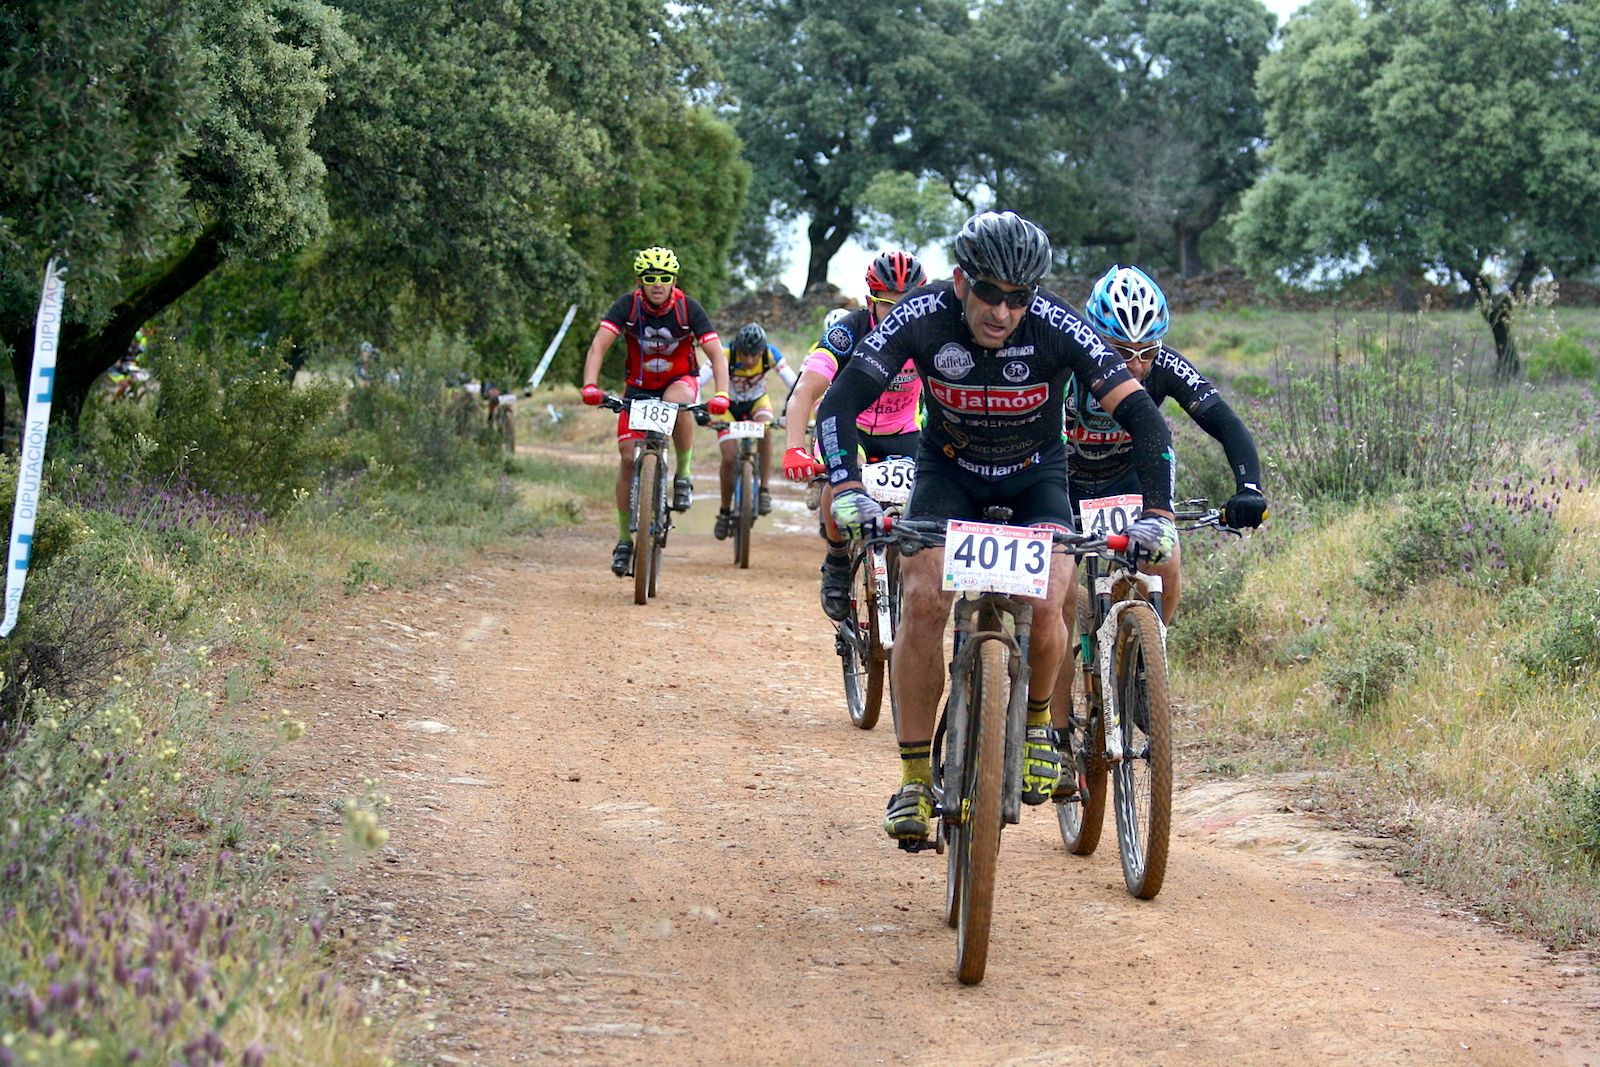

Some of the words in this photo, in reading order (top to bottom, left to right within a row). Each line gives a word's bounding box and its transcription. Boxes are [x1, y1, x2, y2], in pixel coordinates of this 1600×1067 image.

[935, 353, 973, 369] Caffetal
[934, 388, 953, 404] el
[958, 389, 1043, 409] jamón
[641, 404, 670, 424] 185
[19, 420, 44, 520] DIPUTACIÓN
[953, 534, 1045, 575] 4013
